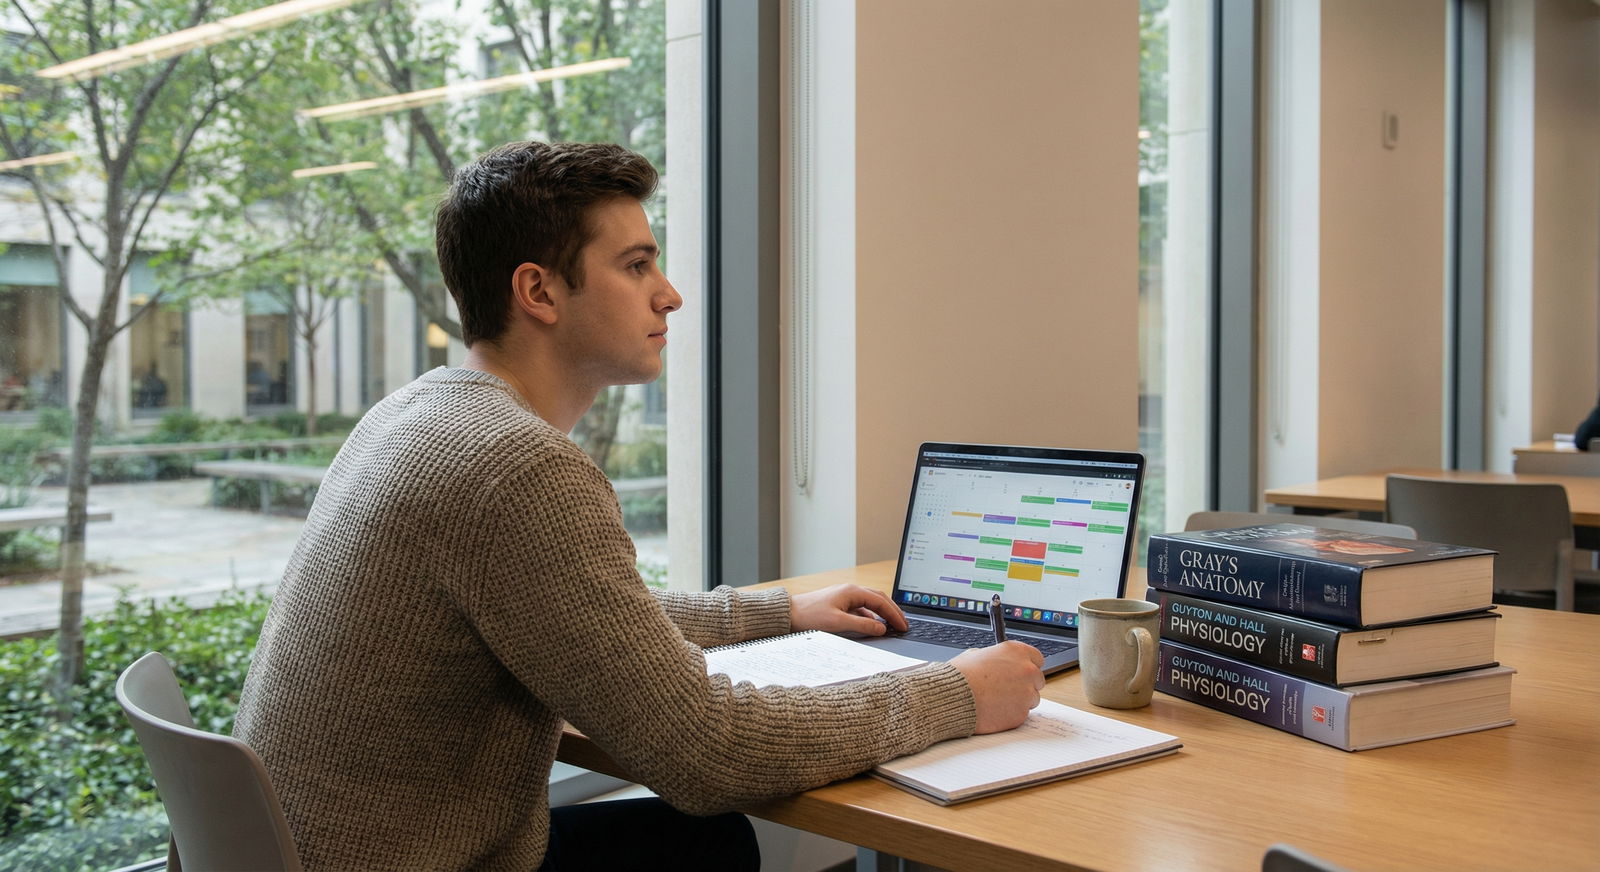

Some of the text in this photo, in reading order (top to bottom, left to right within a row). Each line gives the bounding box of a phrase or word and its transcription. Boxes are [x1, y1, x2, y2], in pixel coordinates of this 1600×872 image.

[1179, 549, 1238, 574] GRAY'S
[1179, 570, 1264, 600] ANATOMY
[1171, 617, 1266, 654] PHYSIOLOGY
[1172, 603, 1213, 620] GUYTON
[1214, 612, 1237, 626] AND
[1239, 618, 1267, 634] HALL
[1172, 655, 1214, 676] GUYTON
[1216, 668, 1240, 683] AND
[1242, 676, 1270, 692] HALL
[1171, 669, 1270, 713] PHYSIOLOGY
